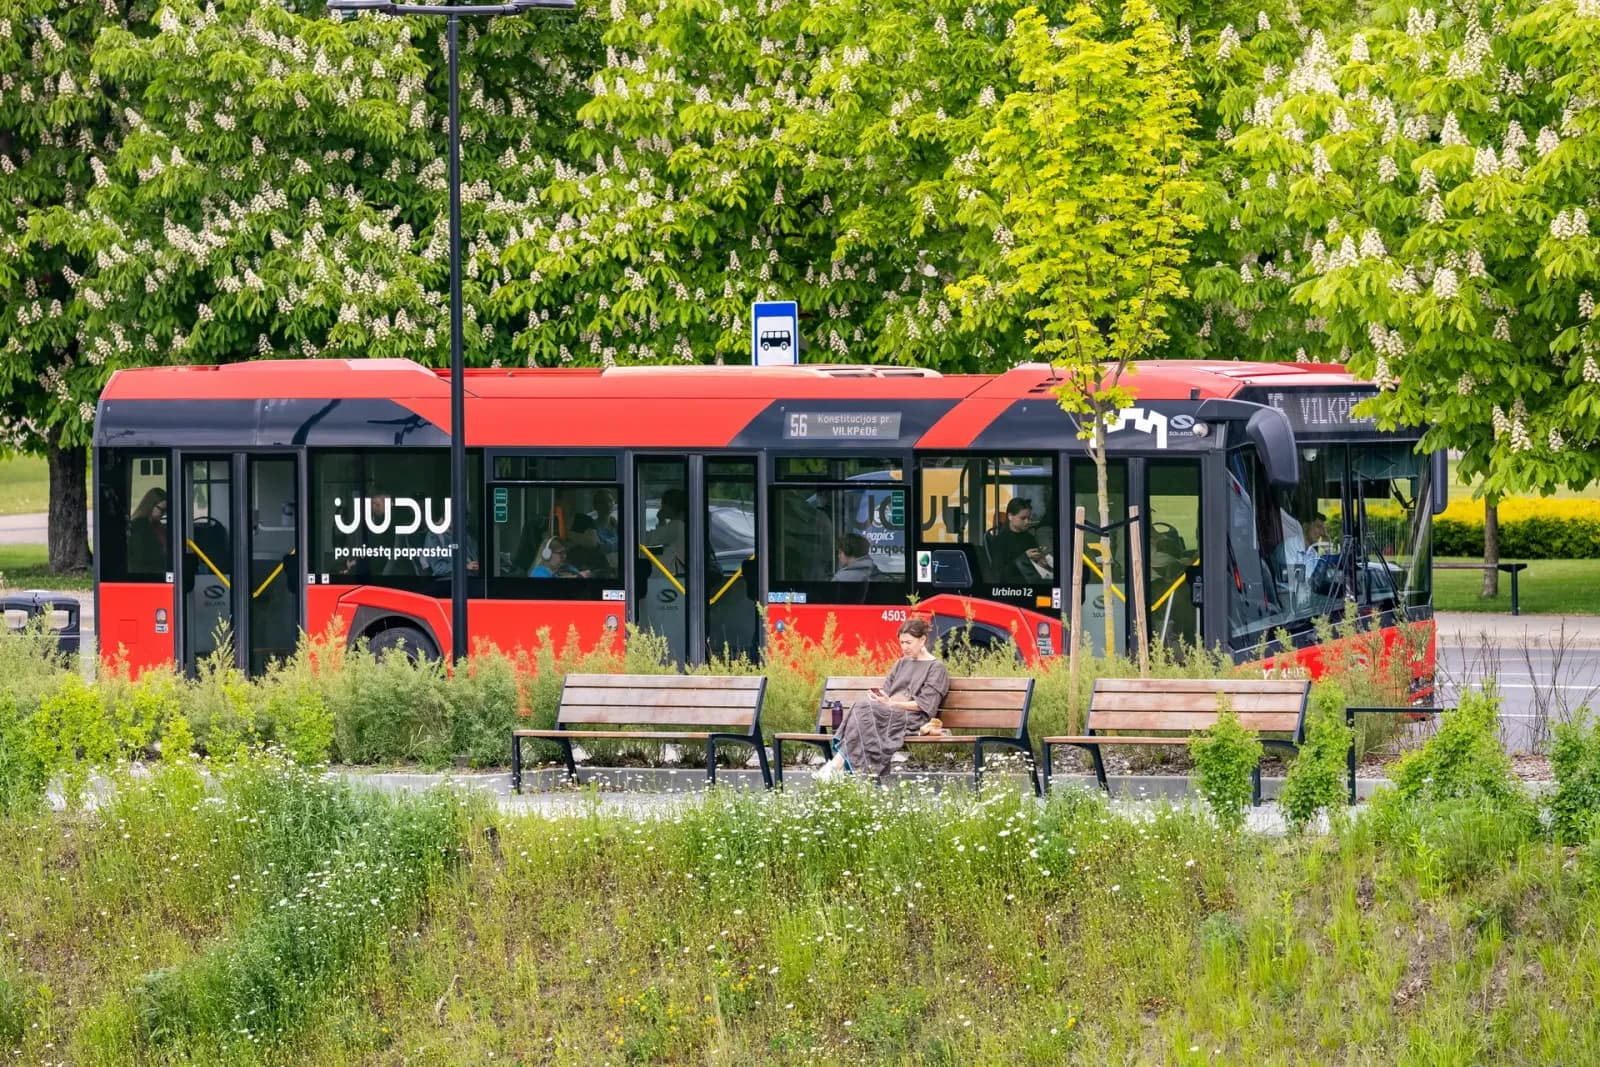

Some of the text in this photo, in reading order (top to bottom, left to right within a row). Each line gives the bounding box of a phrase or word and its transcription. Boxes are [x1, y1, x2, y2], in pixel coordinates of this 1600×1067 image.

[817, 413, 892, 425] Konstitucijos pr.
[790, 414, 808, 437] 56
[334, 544, 453, 560] po miestą paprastai
[992, 587, 1033, 597] Urbino 12
[881, 610, 907, 622] 4503
